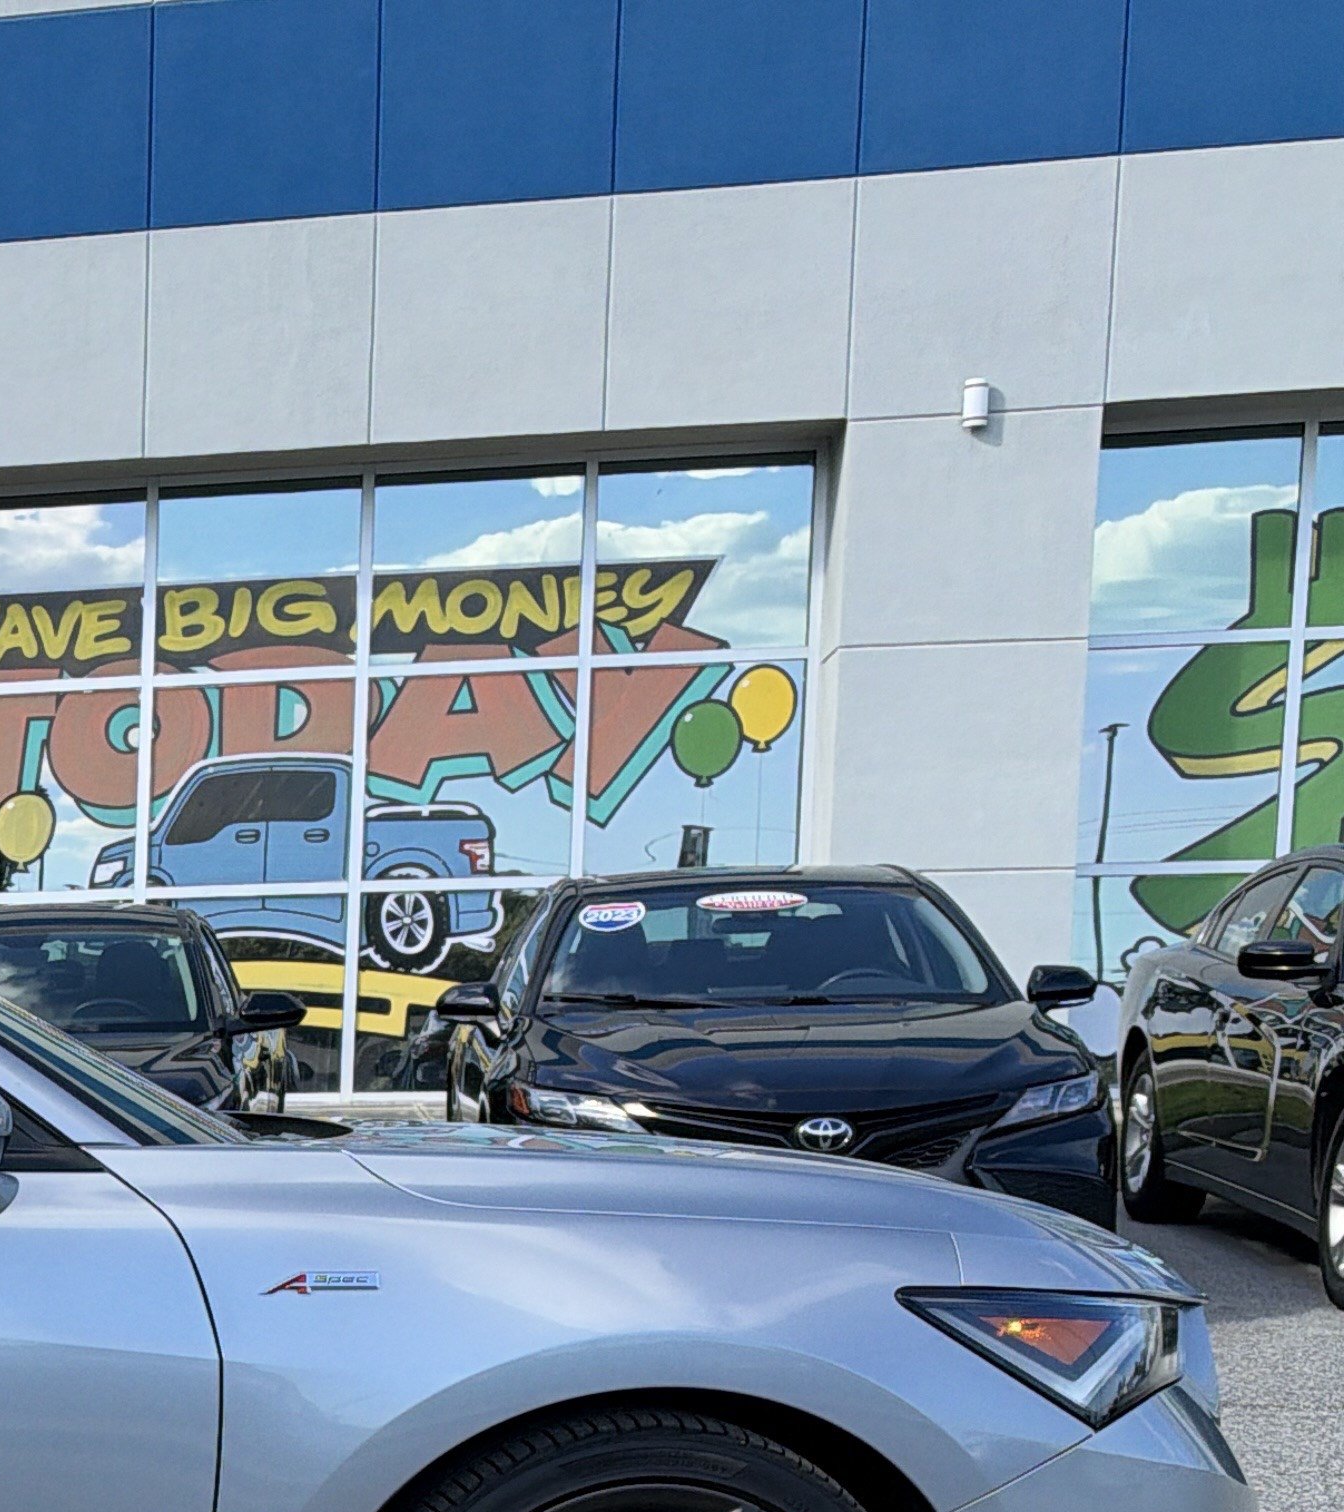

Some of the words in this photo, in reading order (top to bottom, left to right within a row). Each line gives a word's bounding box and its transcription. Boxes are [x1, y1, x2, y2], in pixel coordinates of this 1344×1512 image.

[158, 580, 337, 651] BIG
[351, 569, 695, 640] MONEY
[584, 909, 639, 923] 2023
